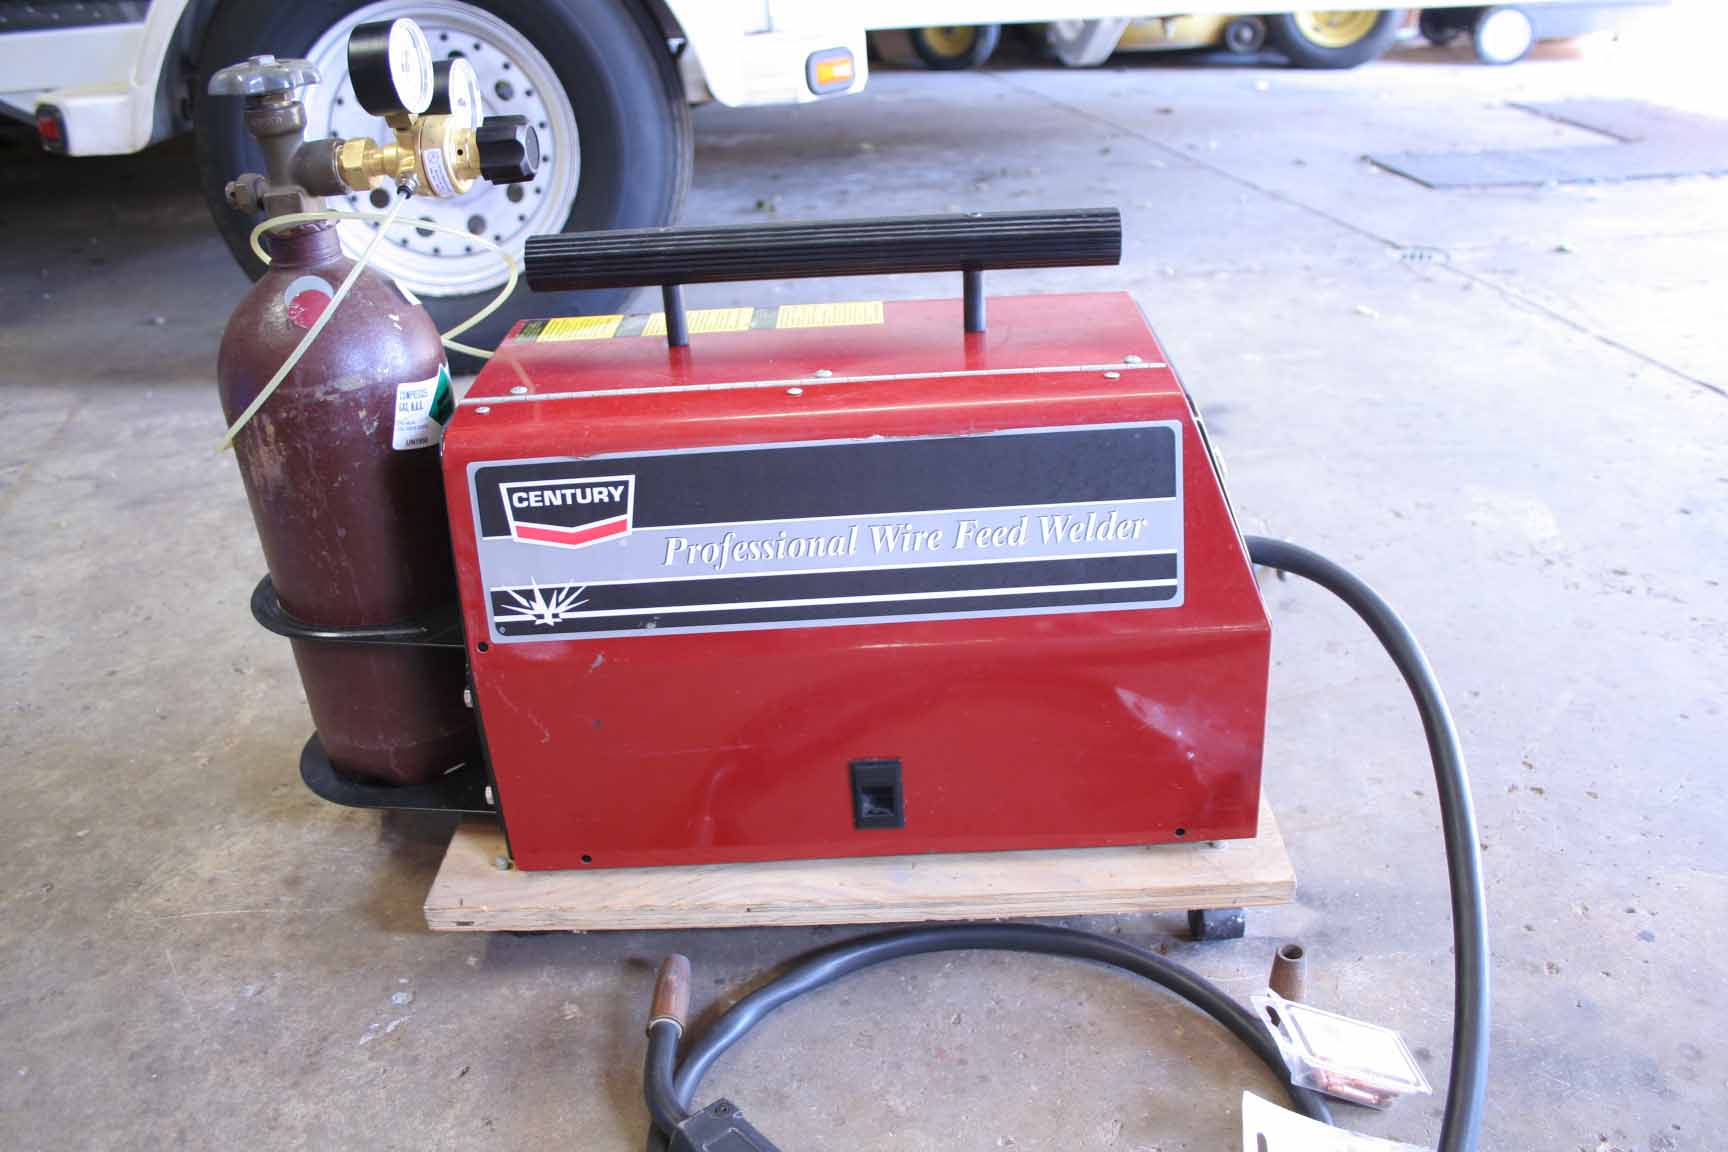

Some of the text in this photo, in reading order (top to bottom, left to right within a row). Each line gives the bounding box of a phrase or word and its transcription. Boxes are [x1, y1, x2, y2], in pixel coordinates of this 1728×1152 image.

[512, 485, 625, 508] CENTURY
[662, 510, 1148, 571] Professional Wire Feed Welder
